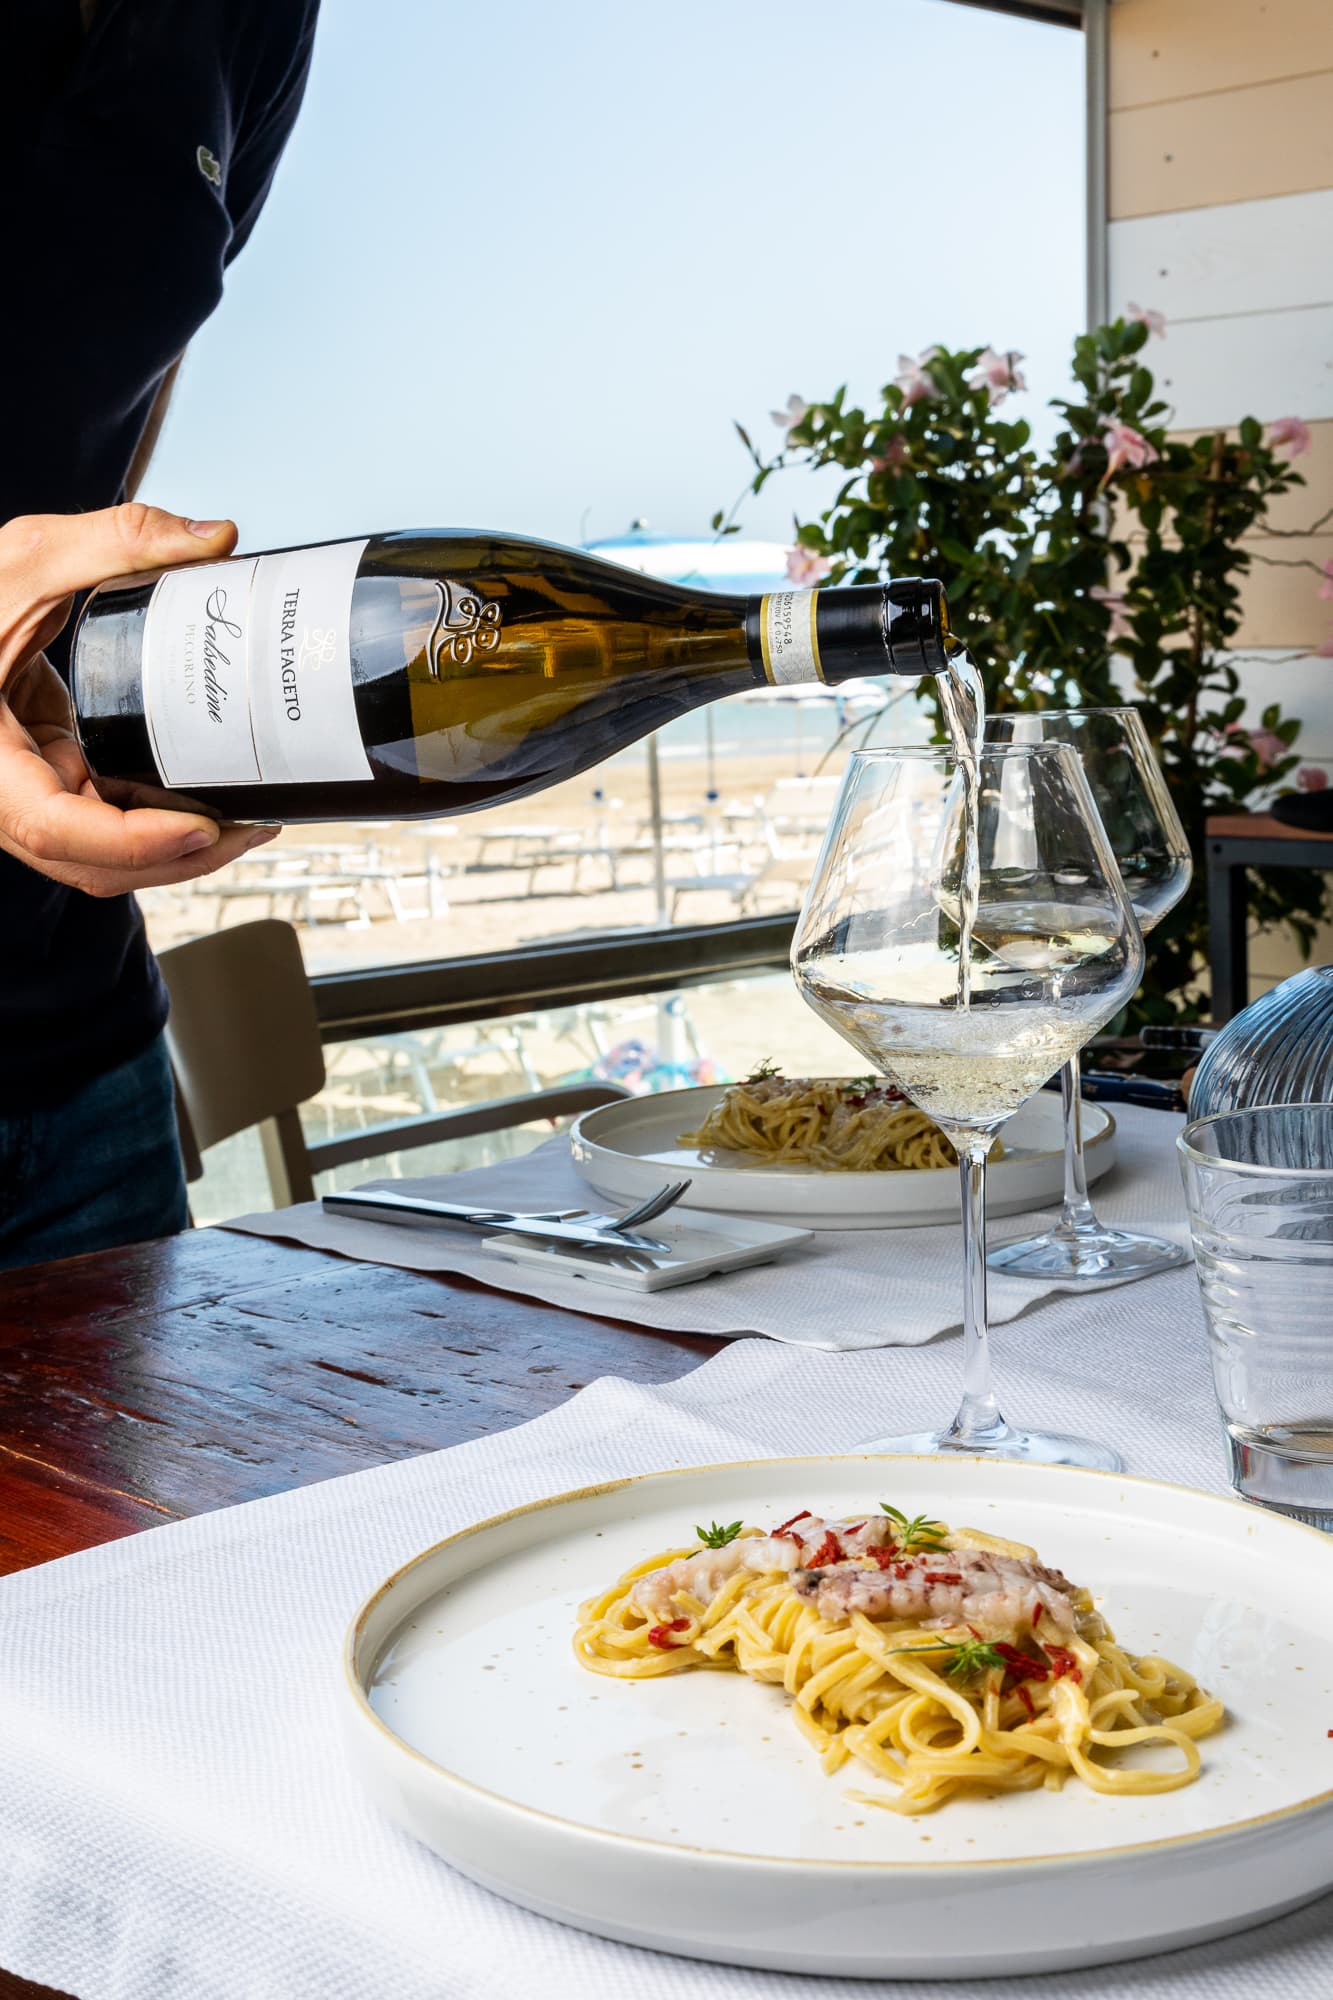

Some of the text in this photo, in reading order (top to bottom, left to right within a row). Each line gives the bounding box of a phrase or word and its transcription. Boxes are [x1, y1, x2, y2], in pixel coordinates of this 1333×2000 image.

[184, 624, 196, 704] PECORINO
[203, 586, 242, 723] Salsedine
[281, 588, 301, 721] TERRA FAGETO
